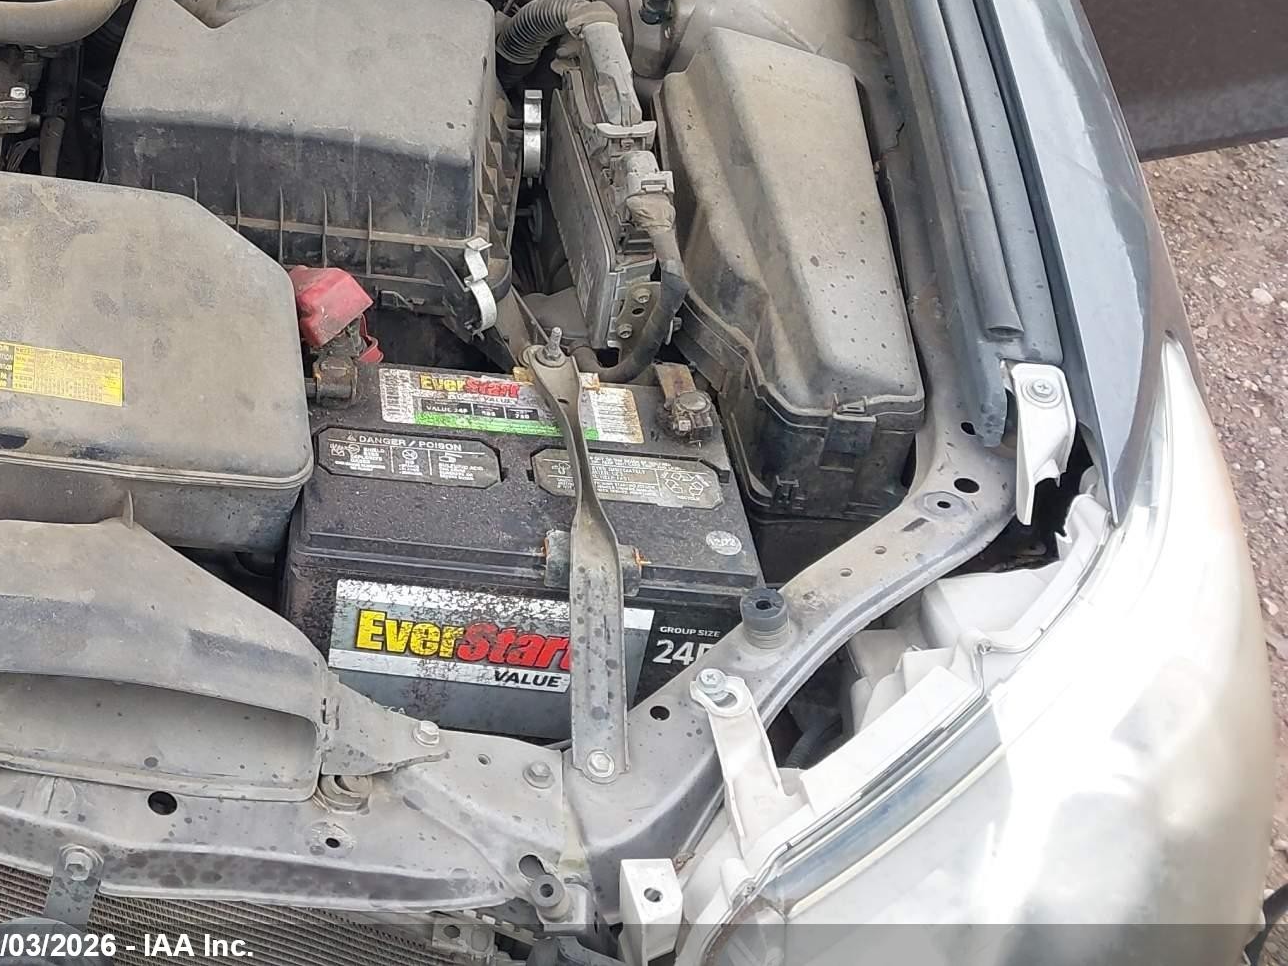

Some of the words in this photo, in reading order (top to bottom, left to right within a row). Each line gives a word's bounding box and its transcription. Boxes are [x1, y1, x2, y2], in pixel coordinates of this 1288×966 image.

[419, 373, 520, 399] EverStart
[358, 435, 407, 447] DANGER
[418, 440, 463, 452] POISON
[356, 609, 571, 670] EverStar
[659, 626, 697, 635] GROUP
[697, 629, 721, 638] SIZE
[493, 669, 562, 688] VALUE
